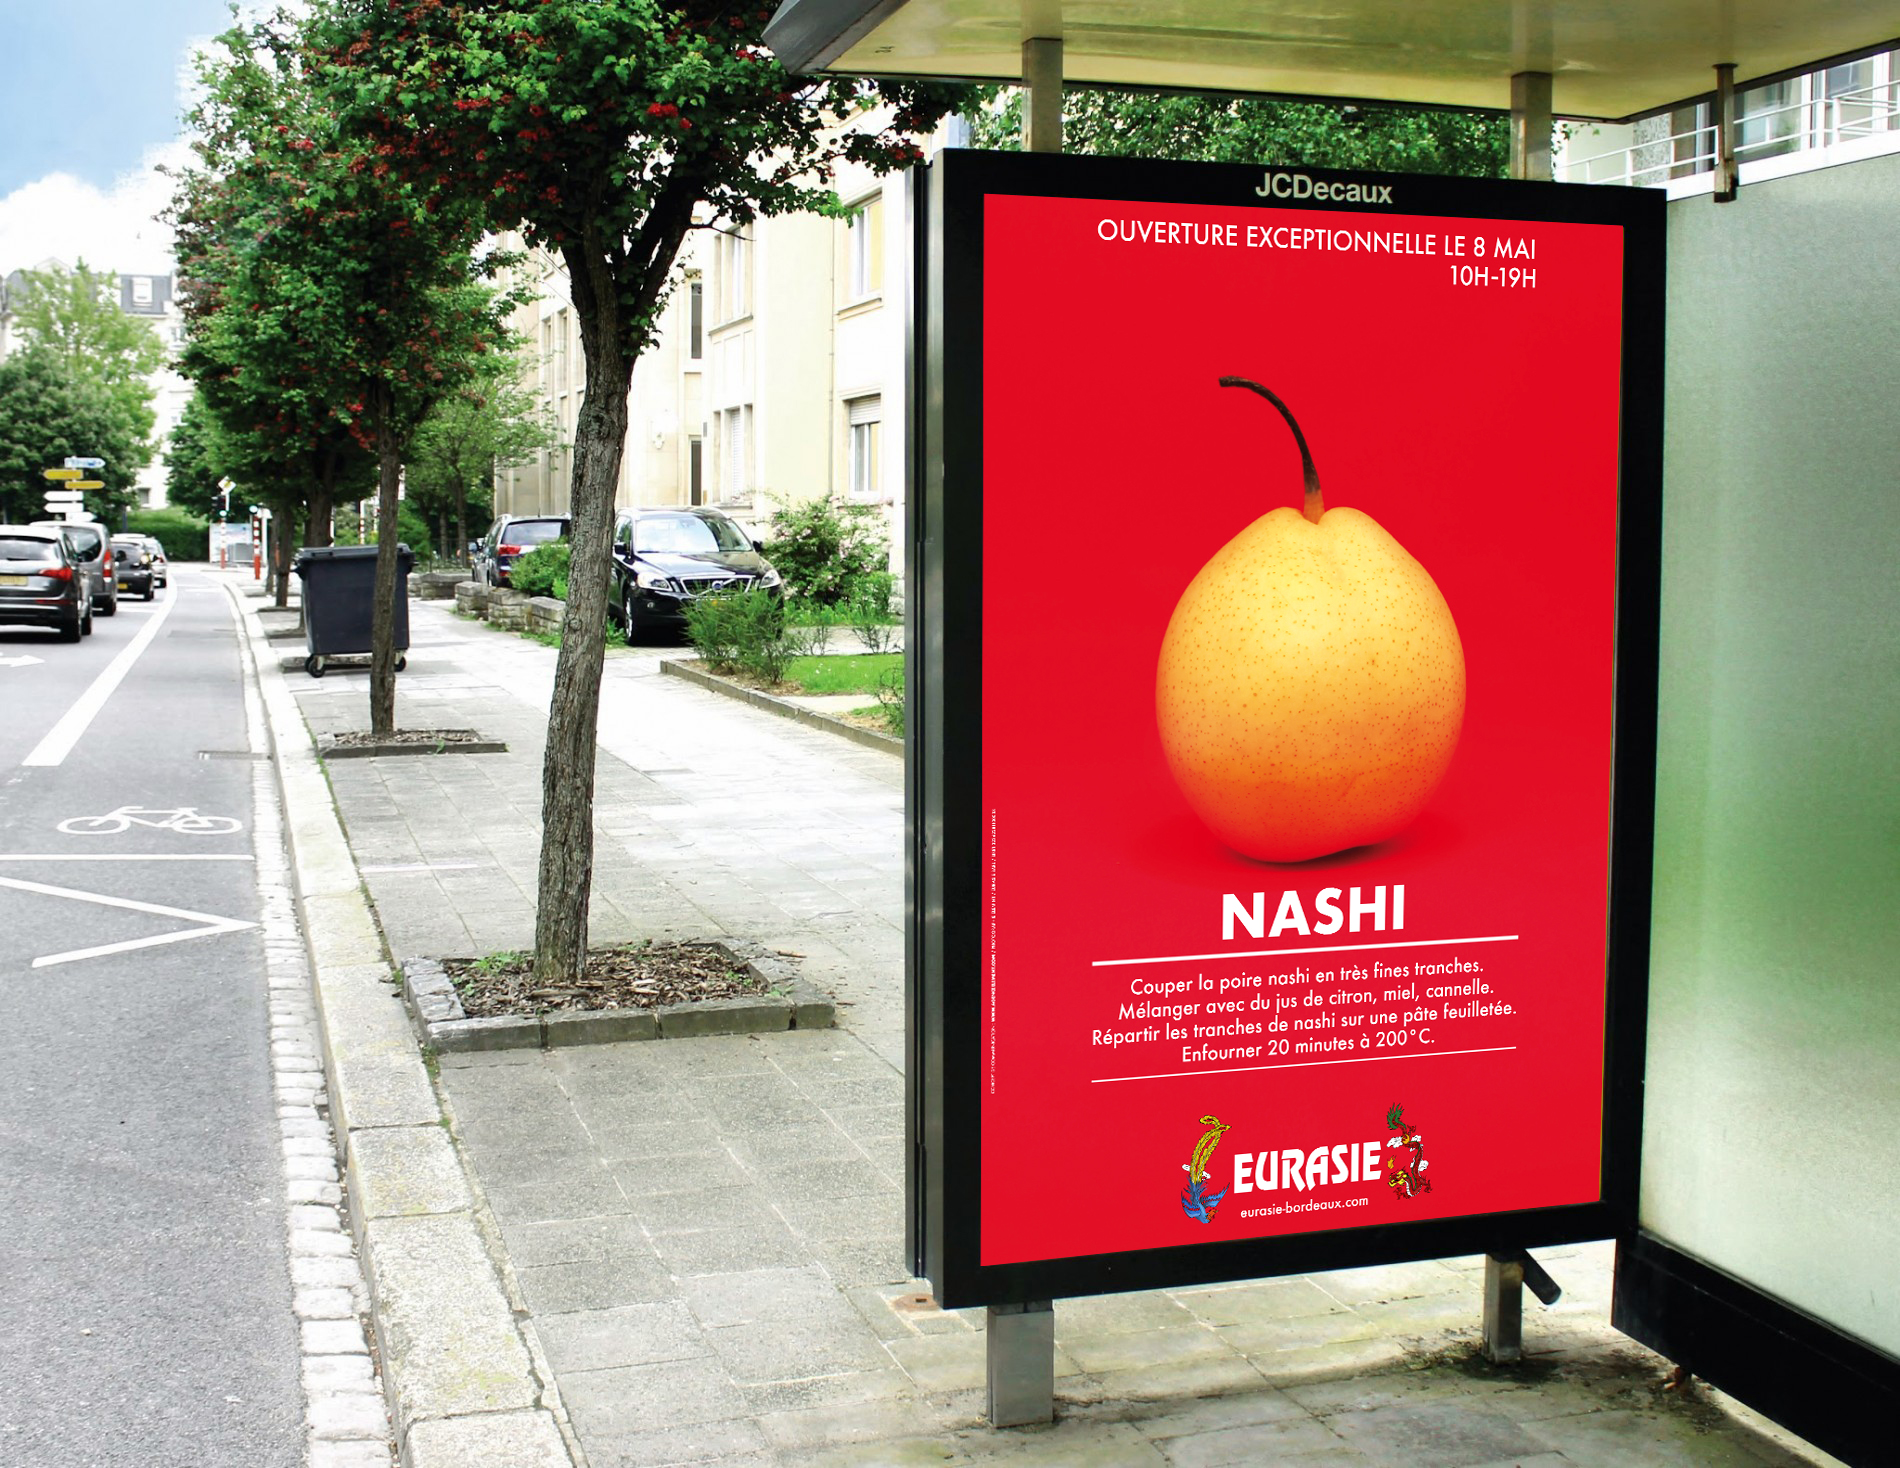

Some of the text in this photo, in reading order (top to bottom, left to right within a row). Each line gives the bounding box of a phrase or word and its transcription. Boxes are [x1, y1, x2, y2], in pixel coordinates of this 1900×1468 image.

[1255, 172, 1394, 205] JCDecaux
[1097, 218, 1536, 260] OUVERTURE EXCEPTIONNELLE LE 8 MAI
[1450, 264, 1537, 289] 10H-19H
[1221, 884, 1405, 941] NASHI
[1130, 956, 1484, 999] Couper la poire nashi en très fines tranches.
[1118, 977, 1494, 1021] Mélanger avec du jus de citron, miel, cannelle.
[1092, 999, 1517, 1049] Répartir les tranches de nashi sur une pâte feuilletée.
[1182, 1042, 1263, 1063] Enfourner
[1267, 1038, 1290, 1056] 20
[1295, 1036, 1355, 1054] minutes
[1359, 1032, 1370, 1049] à
[1233, 1140, 1382, 1194] EURASIE
[1240, 1197, 1369, 1219] eurasie-bordeaux.com
